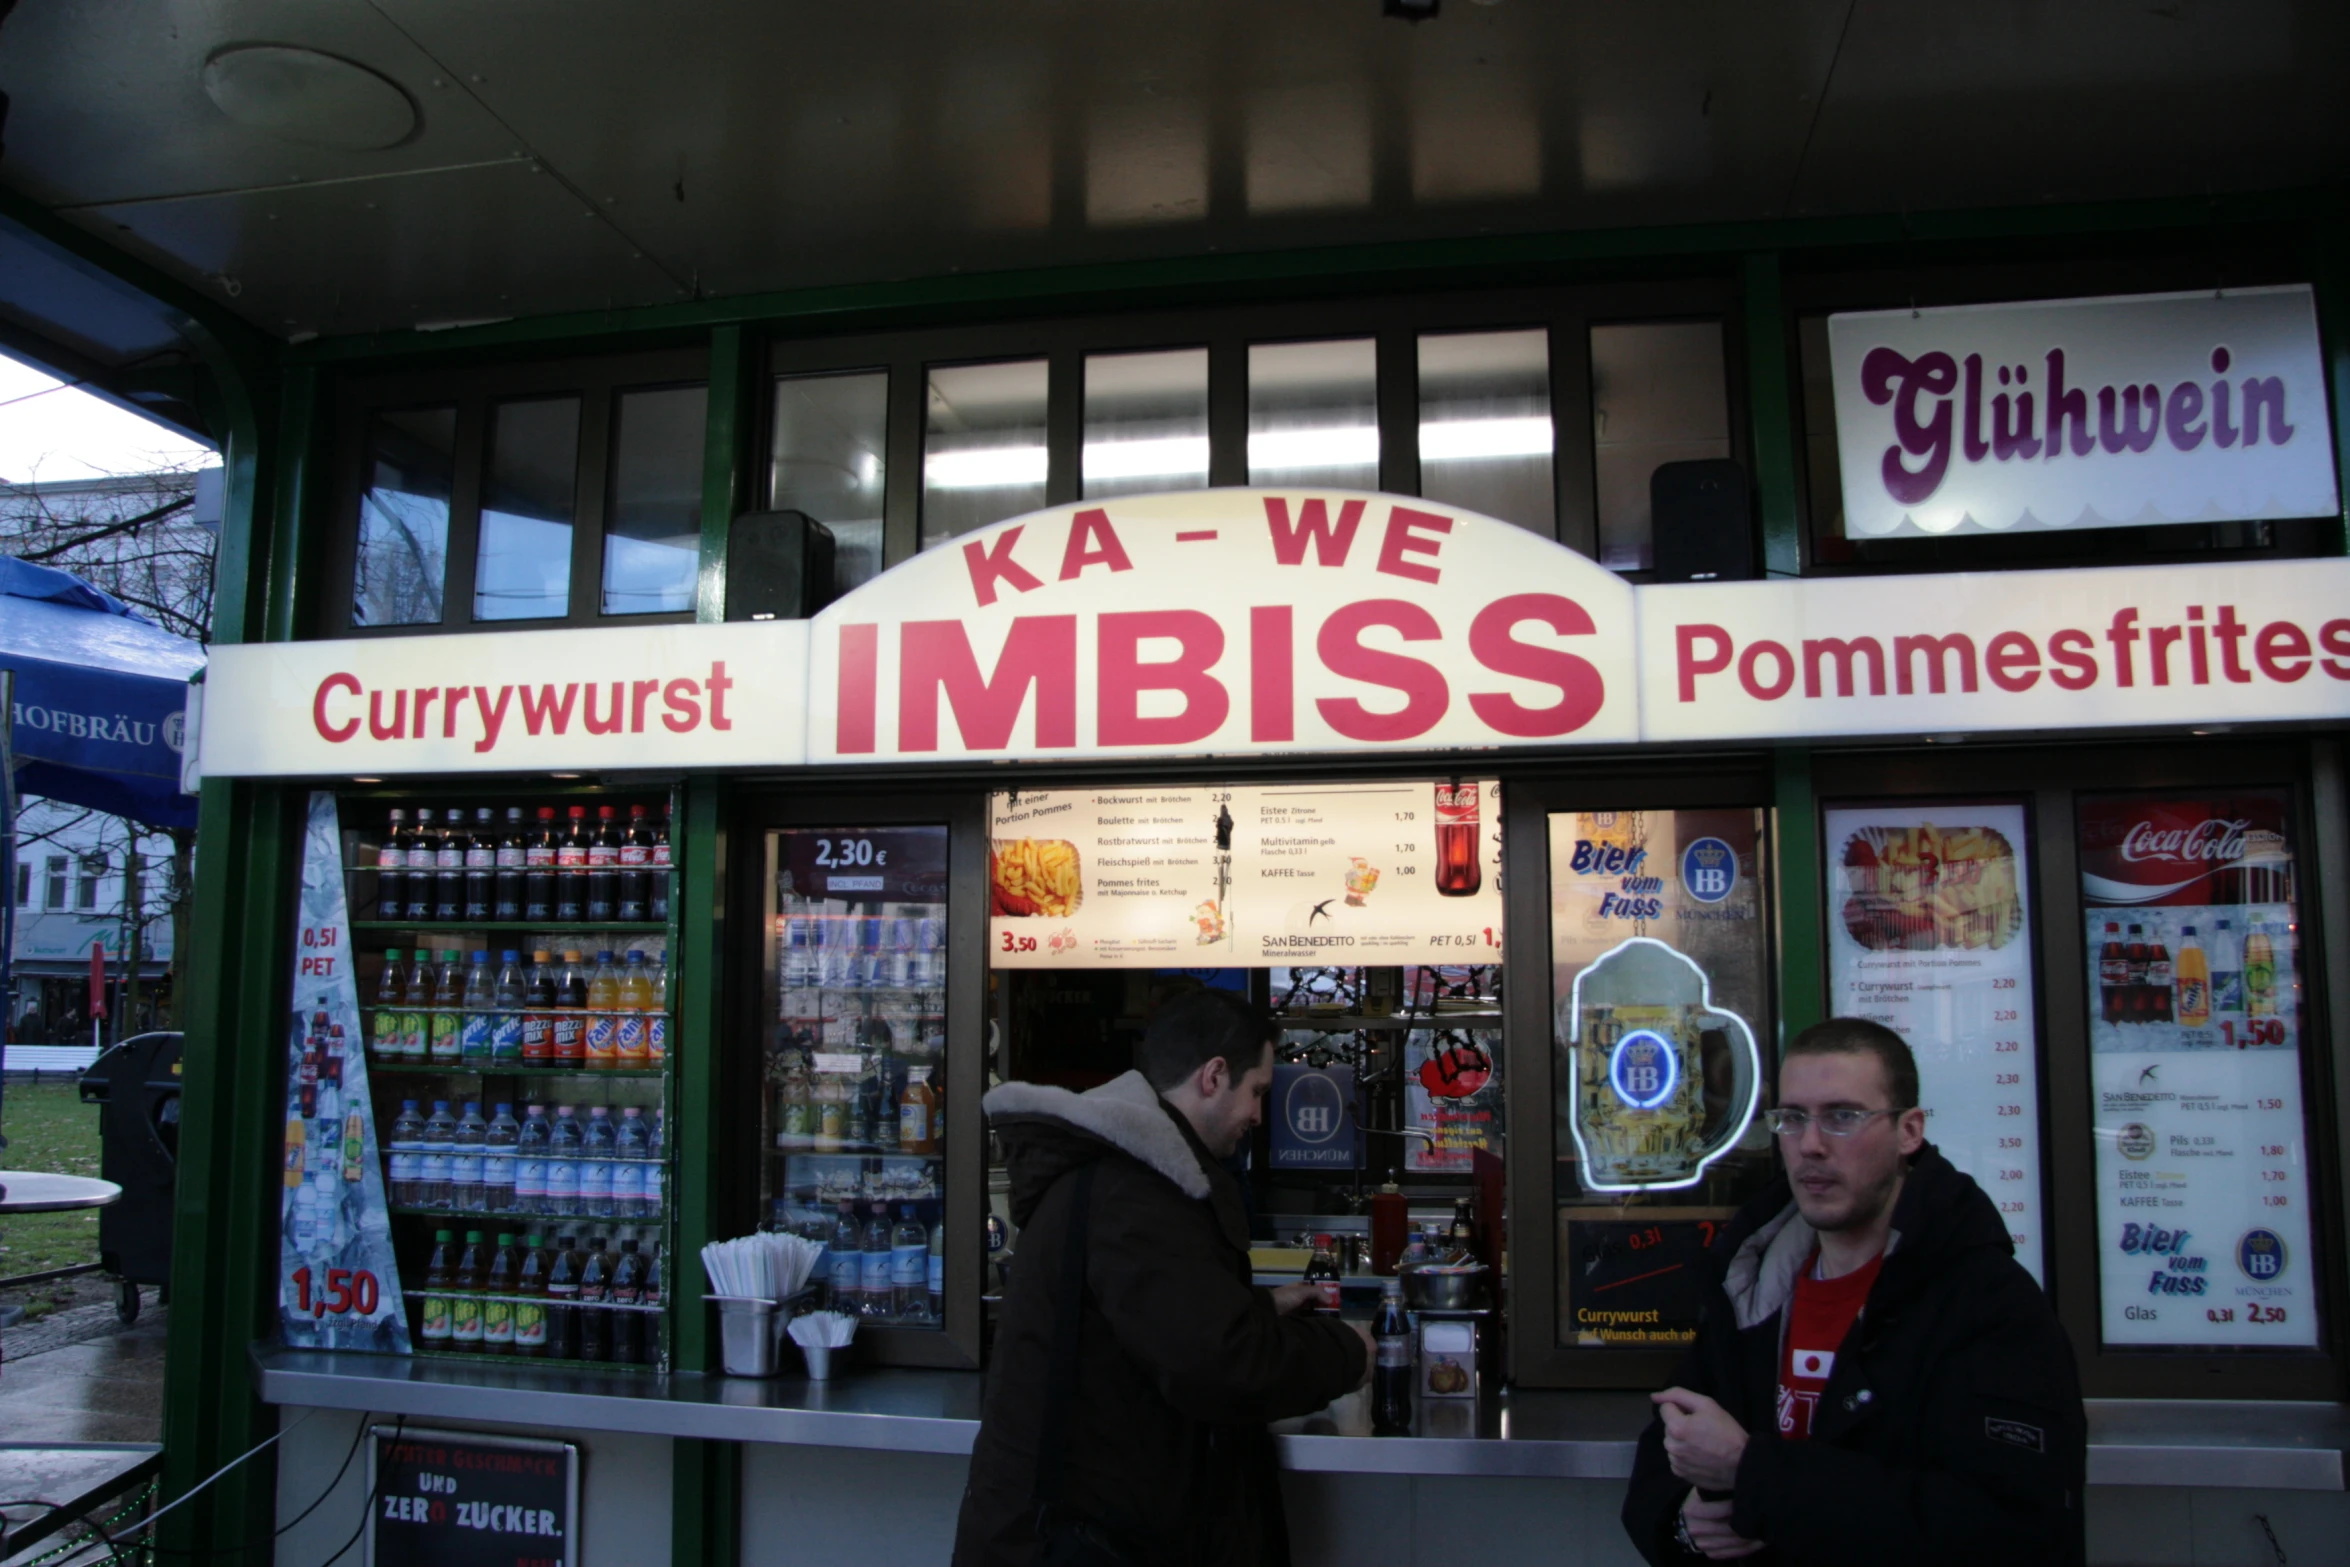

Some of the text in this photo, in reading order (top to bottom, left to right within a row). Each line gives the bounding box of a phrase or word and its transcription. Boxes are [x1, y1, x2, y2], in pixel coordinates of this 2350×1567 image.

[1861, 346, 2294, 506] Glühwein
[1676, 605, 2350, 703] Pommesfrites
[836, 592, 1605, 754] IMBISS
[313, 661, 733, 754] Currywurst
[1025, 793, 1048, 805] einer
[1097, 793, 1231, 805] Bockwurst mit Brötchen 2,20
[995, 803, 1072, 826] Portion Pommes
[1261, 807, 1415, 821] Eistee Zitrone 1,70
[1097, 816, 1183, 826] Boulette mit Brötchen
[1097, 837, 1159, 846] Rostbratwurst
[1162, 837, 1174, 845] mit
[1177, 836, 1207, 845] Brötchen
[1261, 837, 1335, 847] Multivitamin gelb
[2121, 819, 2252, 862] Coca-Cola
[815, 838, 887, 869] 2,30 €
[1395, 843, 1415, 853] 1,70
[1097, 857, 1150, 867] Fleischspieß
[1153, 858, 1164, 866] mit
[1168, 857, 1198, 866] Brötchen
[1570, 840, 1647, 875] Bier
[1261, 869, 1295, 878] KAFFEE
[1395, 866, 1416, 876] 1,00
[852, 878, 882, 888] PFAND
[1097, 876, 1232, 888] Pommes frites 2,0
[1621, 876, 1664, 894] vom
[1694, 868, 1726, 893] HB
[1111, 888, 1149, 898] Majonnaise
[1159, 888, 1187, 898] Ketchup
[1599, 892, 1663, 920] Fass
[1676, 908, 1746, 921] MÜNCHEN
[1002, 931, 1037, 954] 3,50
[1263, 935, 1288, 947] SAN
[1289, 935, 1355, 947] BENEDETTO
[1430, 936, 1451, 946] PET
[1262, 949, 1316, 958] Mineralwasser
[302, 957, 335, 976] PET
[1858, 959, 1981, 969] Currywurst mit Portion Pommes
[1858, 982, 1913, 993] Currywurst
[1992, 978, 2016, 989] 2,20
[1858, 994, 1909, 1003] mit Brötchen
[1994, 1010, 2017, 1021] 2,20
[524, 1030, 543, 1043] mix
[555, 1030, 574, 1043] mix
[2219, 1019, 2285, 1049] 1,50
[1995, 1041, 2018, 1052] 2,20
[1627, 1065, 1659, 1092] HB
[1996, 1074, 2019, 1085] 2,30
[2103, 1092, 2124, 1101] SAN
[2124, 1092, 2176, 1101] BENEDETTO
[2181, 1102, 2195, 1111] PET
[2257, 1098, 2282, 1110] 1,50
[1997, 1106, 2021, 1117] 2,30
[1998, 1138, 2022, 1149] 3,50
[2170, 1135, 2189, 1145] Pils
[2170, 1148, 2200, 1157] Flasche
[2260, 1145, 2284, 1156] 1,80
[2000, 1170, 2023, 1180] 2,00
[2119, 1170, 2150, 1180] Eistee
[2119, 1181, 2133, 1189] PET
[2120, 1195, 2286, 1207] KAFFEE Tasse 1,00
[2001, 1202, 2024, 1213] 2,20
[2013, 1234, 2025, 1244] 20
[2119, 1222, 2192, 1256] Bier
[2168, 1255, 2208, 1273] vom
[2250, 1254, 2277, 1274] HB
[2148, 1270, 2209, 1296] Fass
[292, 1268, 379, 1318] 1,50
[2235, 1286, 2292, 1297] MÜNCHEN
[1577, 1307, 1660, 1326] Currywurst
[2125, 1305, 2157, 1320] Glas
[2247, 1303, 2286, 1324] 2,50
[1600, 1328, 1647, 1341] Wunsch
[1650, 1328, 1678, 1341] auch
[1681, 1329, 1697, 1341] oh
[419, 1472, 458, 1495] UND
[384, 1495, 562, 1537] ZERO ZUCKER.
